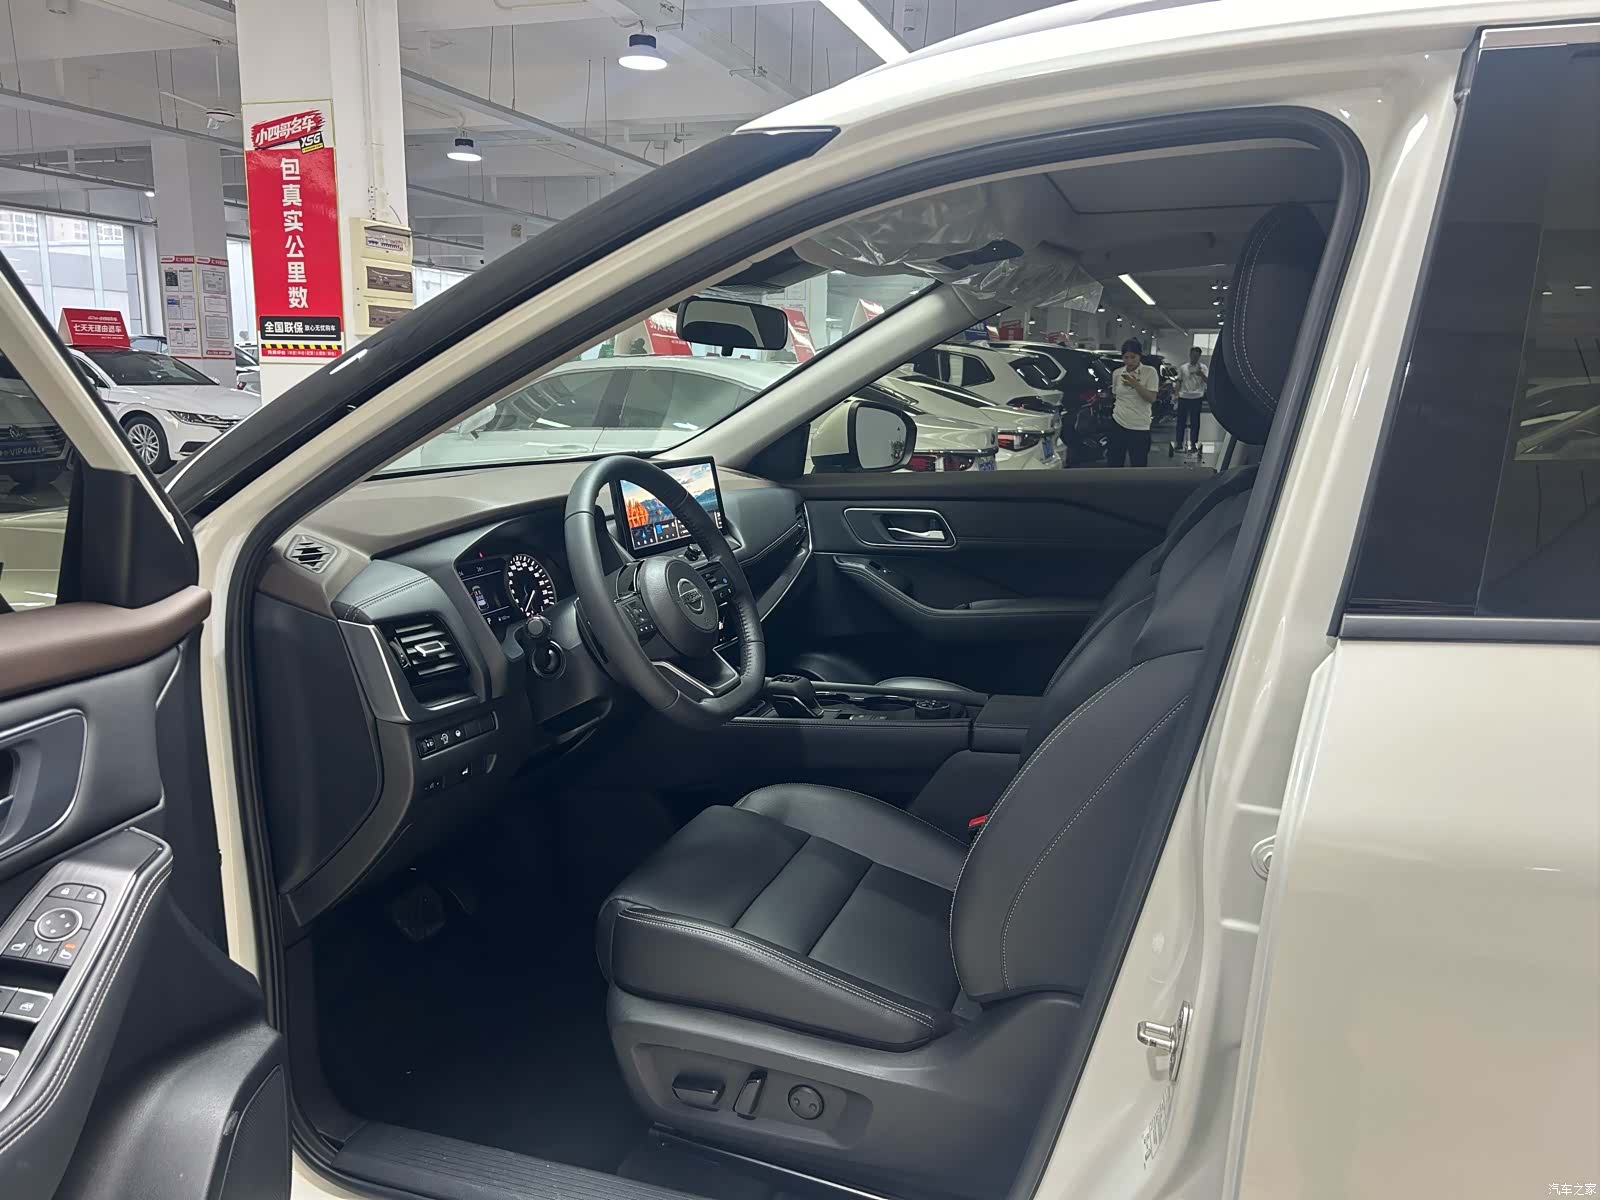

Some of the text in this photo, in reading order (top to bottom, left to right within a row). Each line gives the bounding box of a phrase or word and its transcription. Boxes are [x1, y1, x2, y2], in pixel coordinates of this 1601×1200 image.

[255, 114, 316, 146] 小四哥名车
[300, 132, 321, 148] XSG
[280, 157, 309, 308] 包真实公里数
[264, 321, 304, 334] 全国联保
